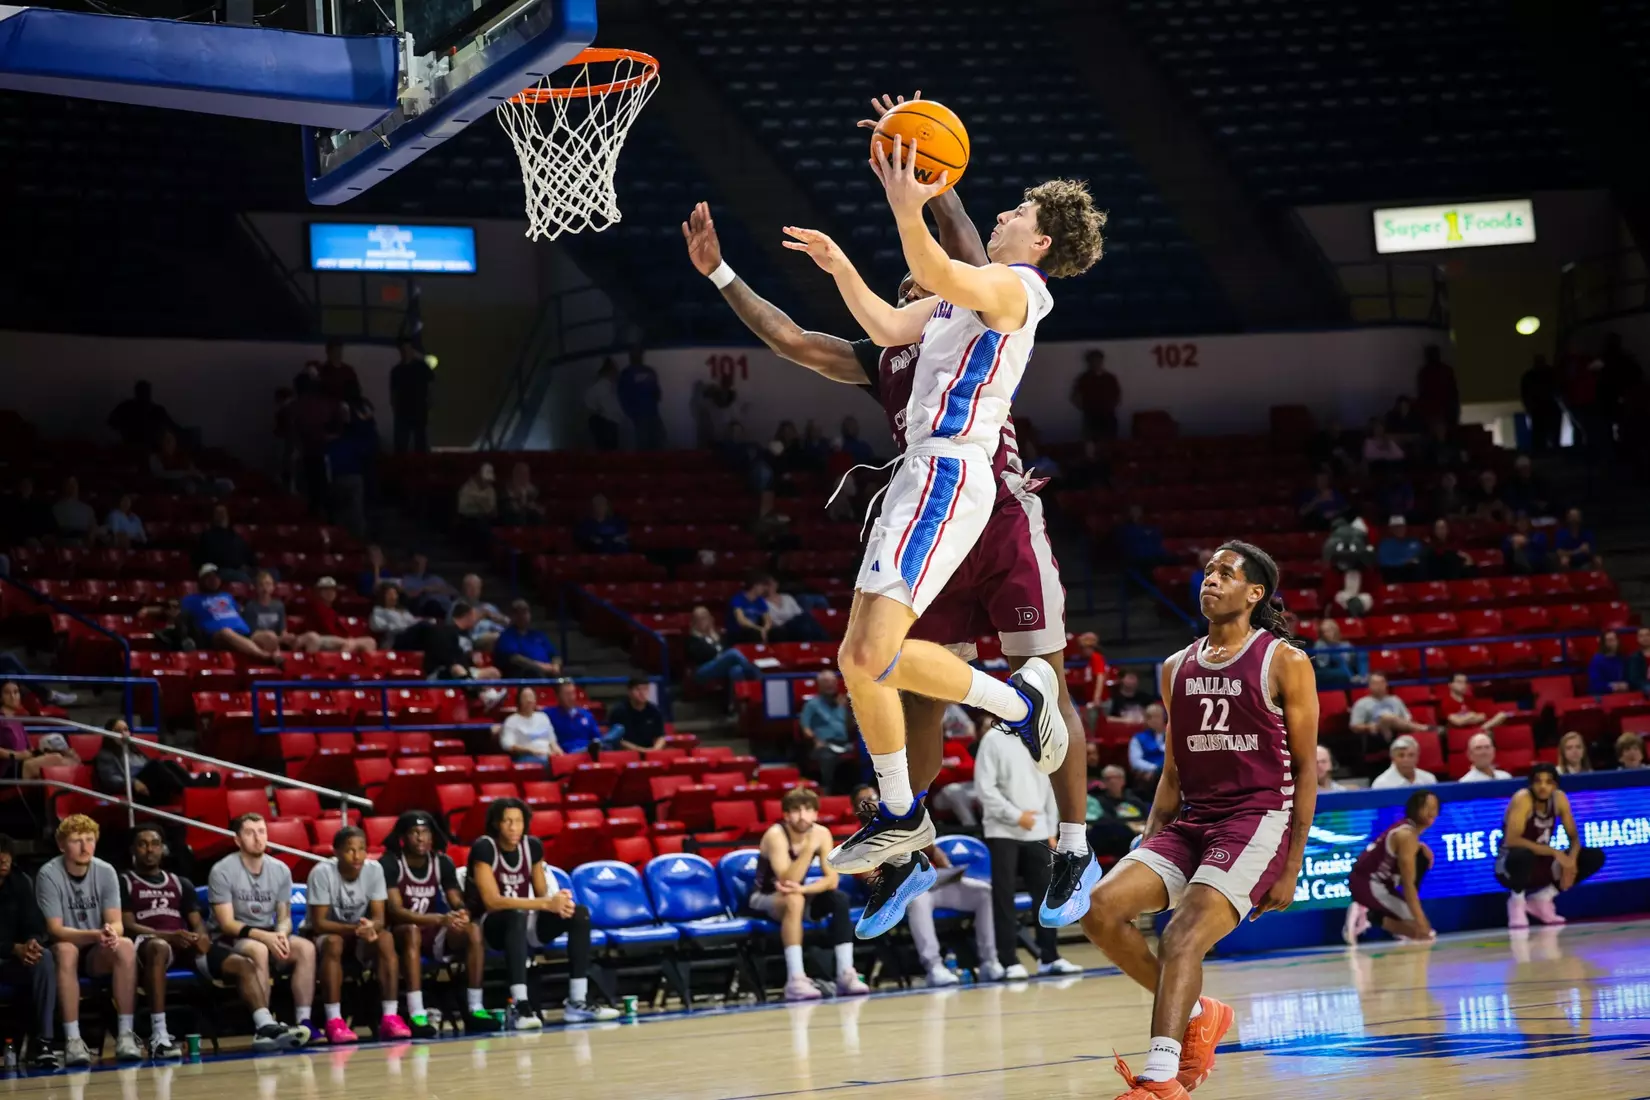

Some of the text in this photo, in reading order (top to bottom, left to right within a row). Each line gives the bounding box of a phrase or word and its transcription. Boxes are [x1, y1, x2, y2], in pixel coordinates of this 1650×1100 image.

[1384, 218, 1440, 239] Super
[1464, 211, 1523, 231] Foods
[705, 354, 748, 380] 101
[1151, 343, 1199, 369] 102
[1185, 677, 1242, 696] DALLAS
[1200, 698, 1230, 731] 22
[1186, 734, 1259, 752] CHRISTIAN
[1441, 831, 1487, 862] THE
